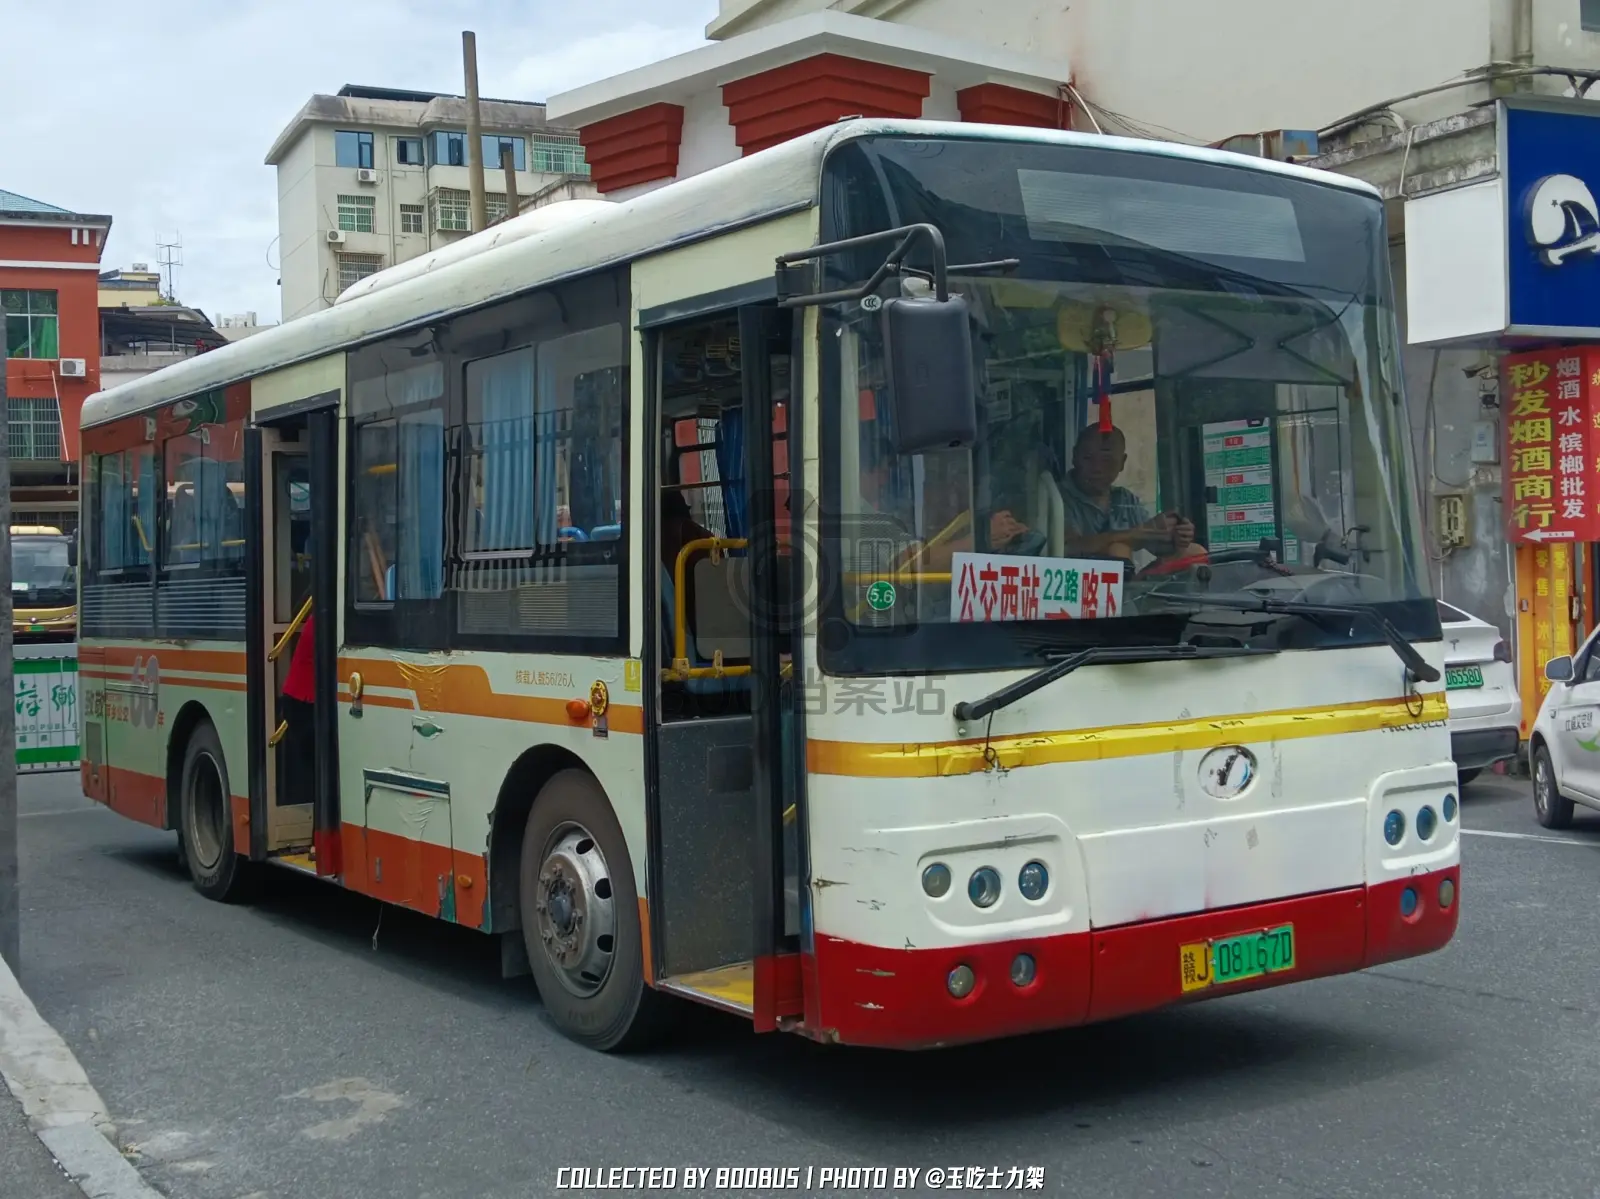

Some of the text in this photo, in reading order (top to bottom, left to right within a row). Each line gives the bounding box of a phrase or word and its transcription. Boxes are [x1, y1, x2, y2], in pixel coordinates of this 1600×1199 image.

[1507, 361, 1556, 528] 秒发烟酒商行
[870, 588, 894, 603] 5.6
[958, 562, 1040, 622] 公交西站
[1043, 568, 1079, 604] 22路
